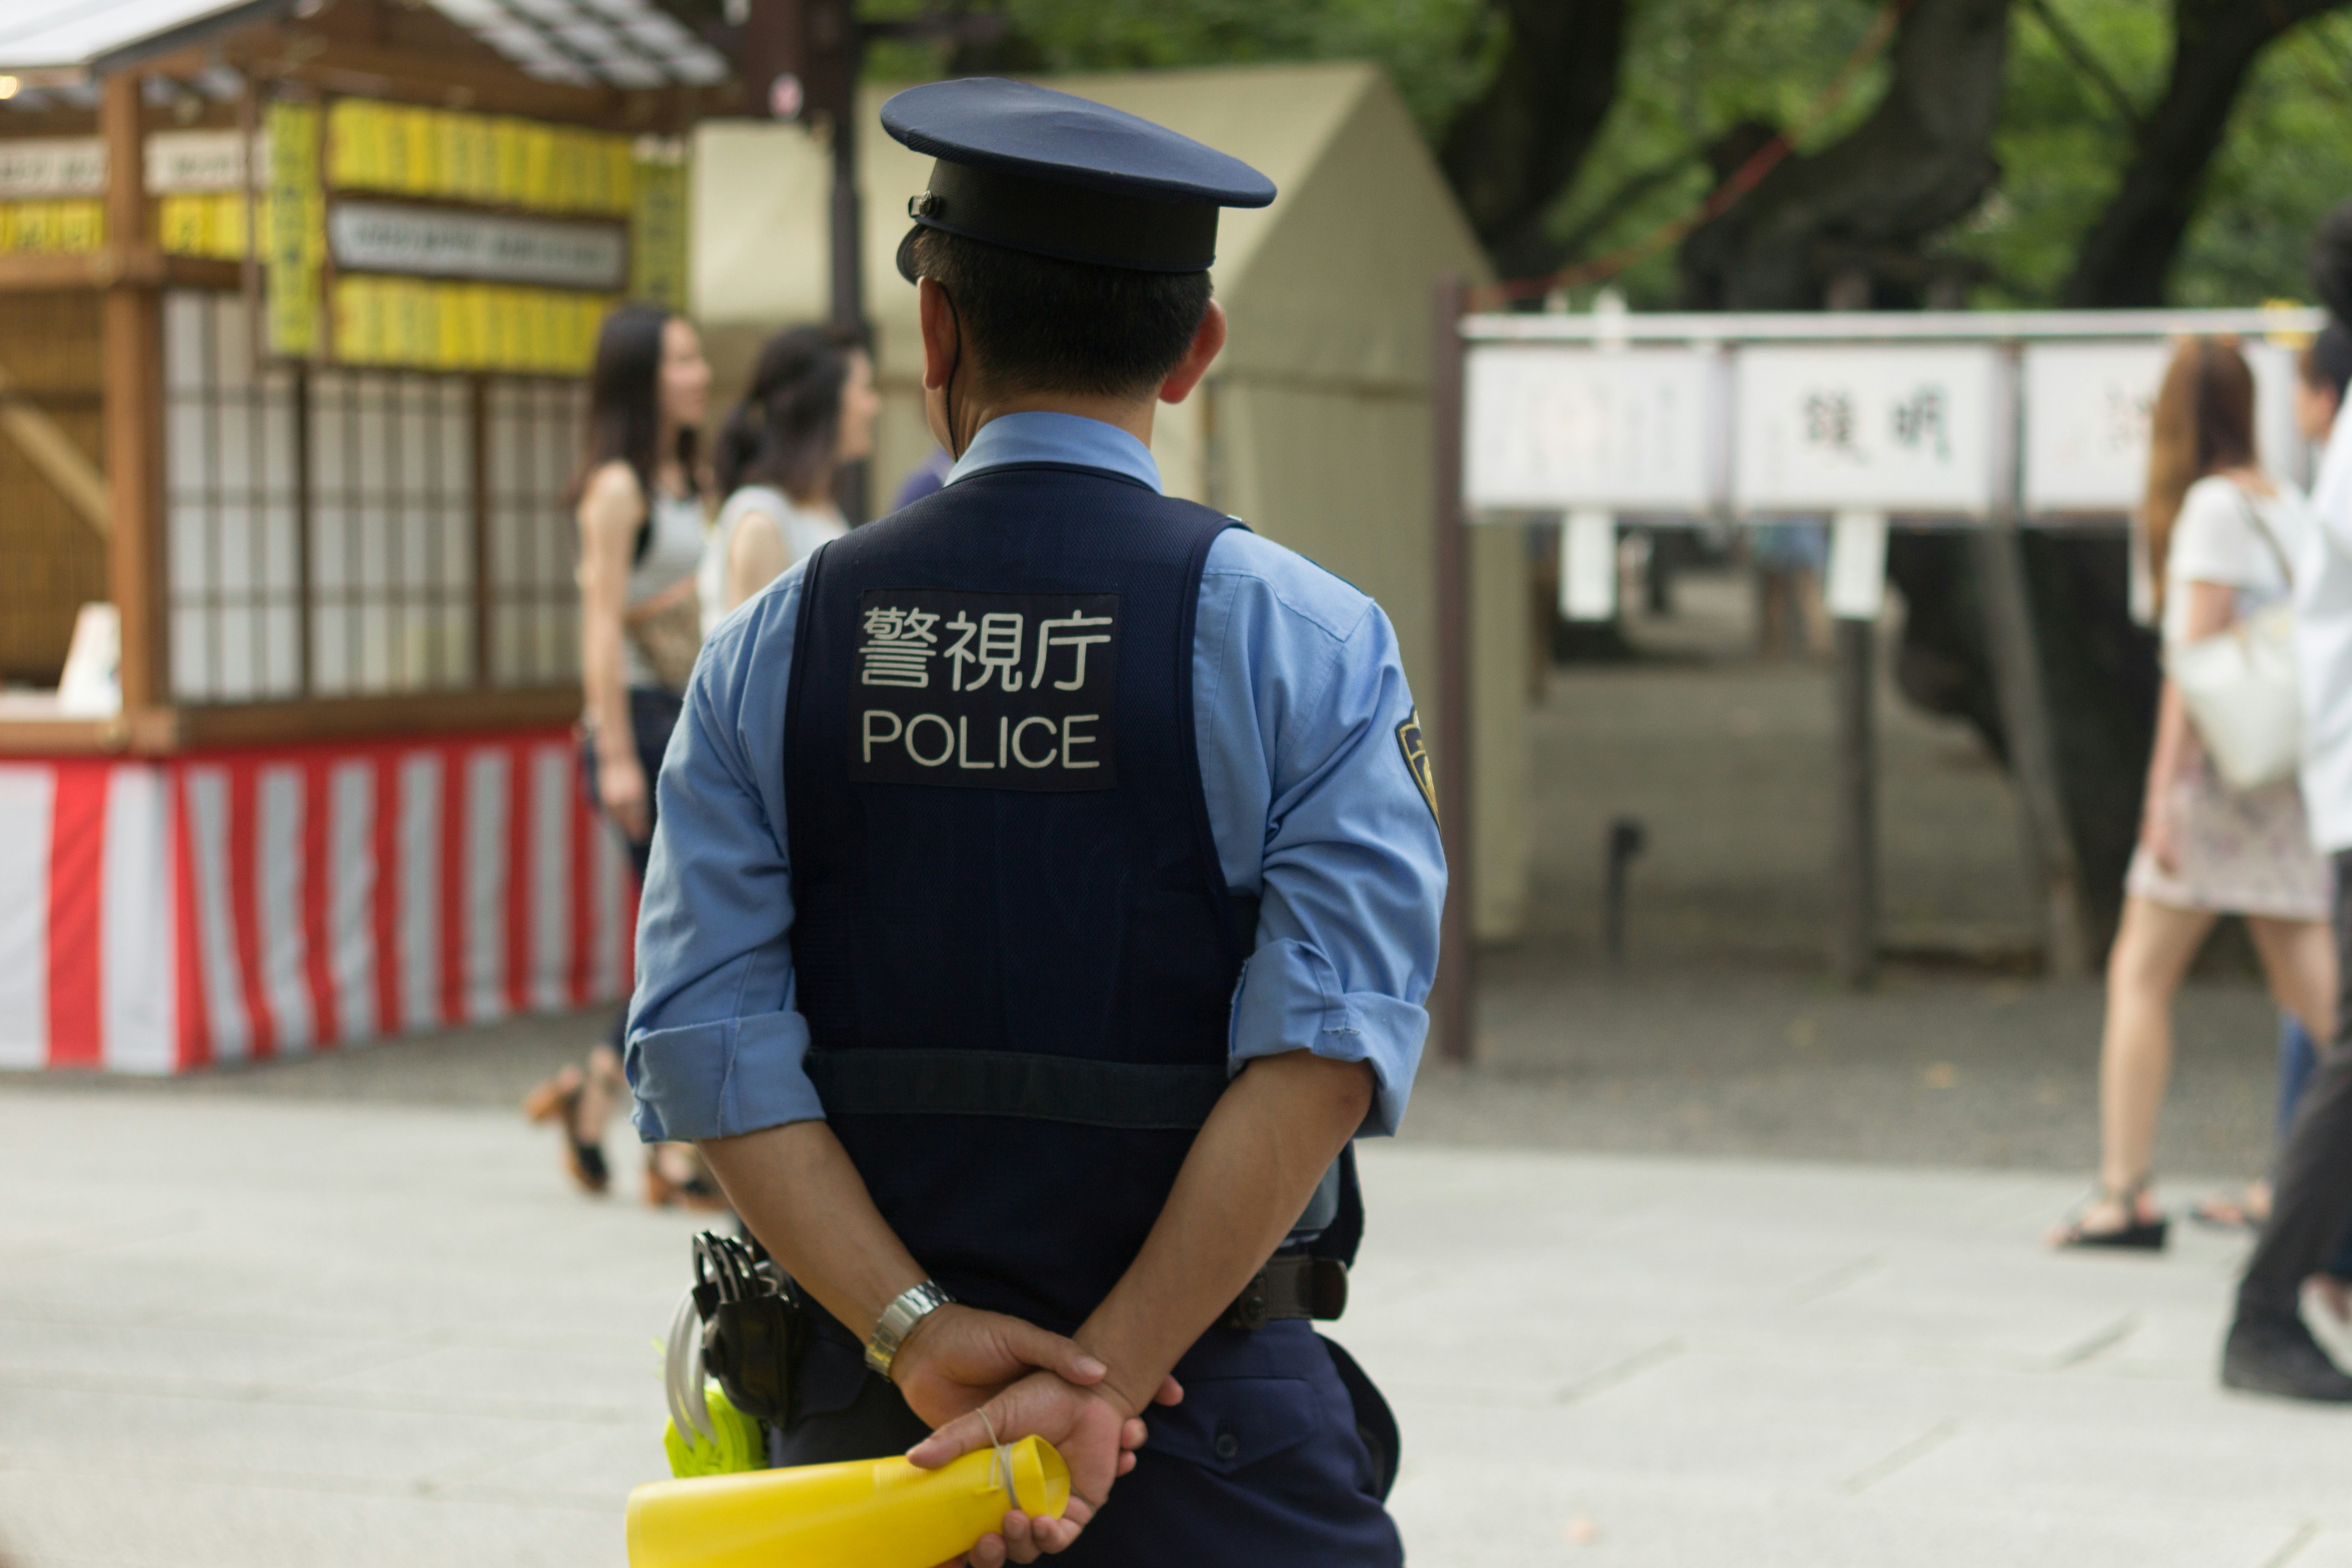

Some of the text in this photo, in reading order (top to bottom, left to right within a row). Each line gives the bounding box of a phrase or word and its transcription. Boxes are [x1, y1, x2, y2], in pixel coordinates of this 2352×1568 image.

[859, 607, 1113, 692] 警視庁
[863, 710, 1100, 769] POLICE
